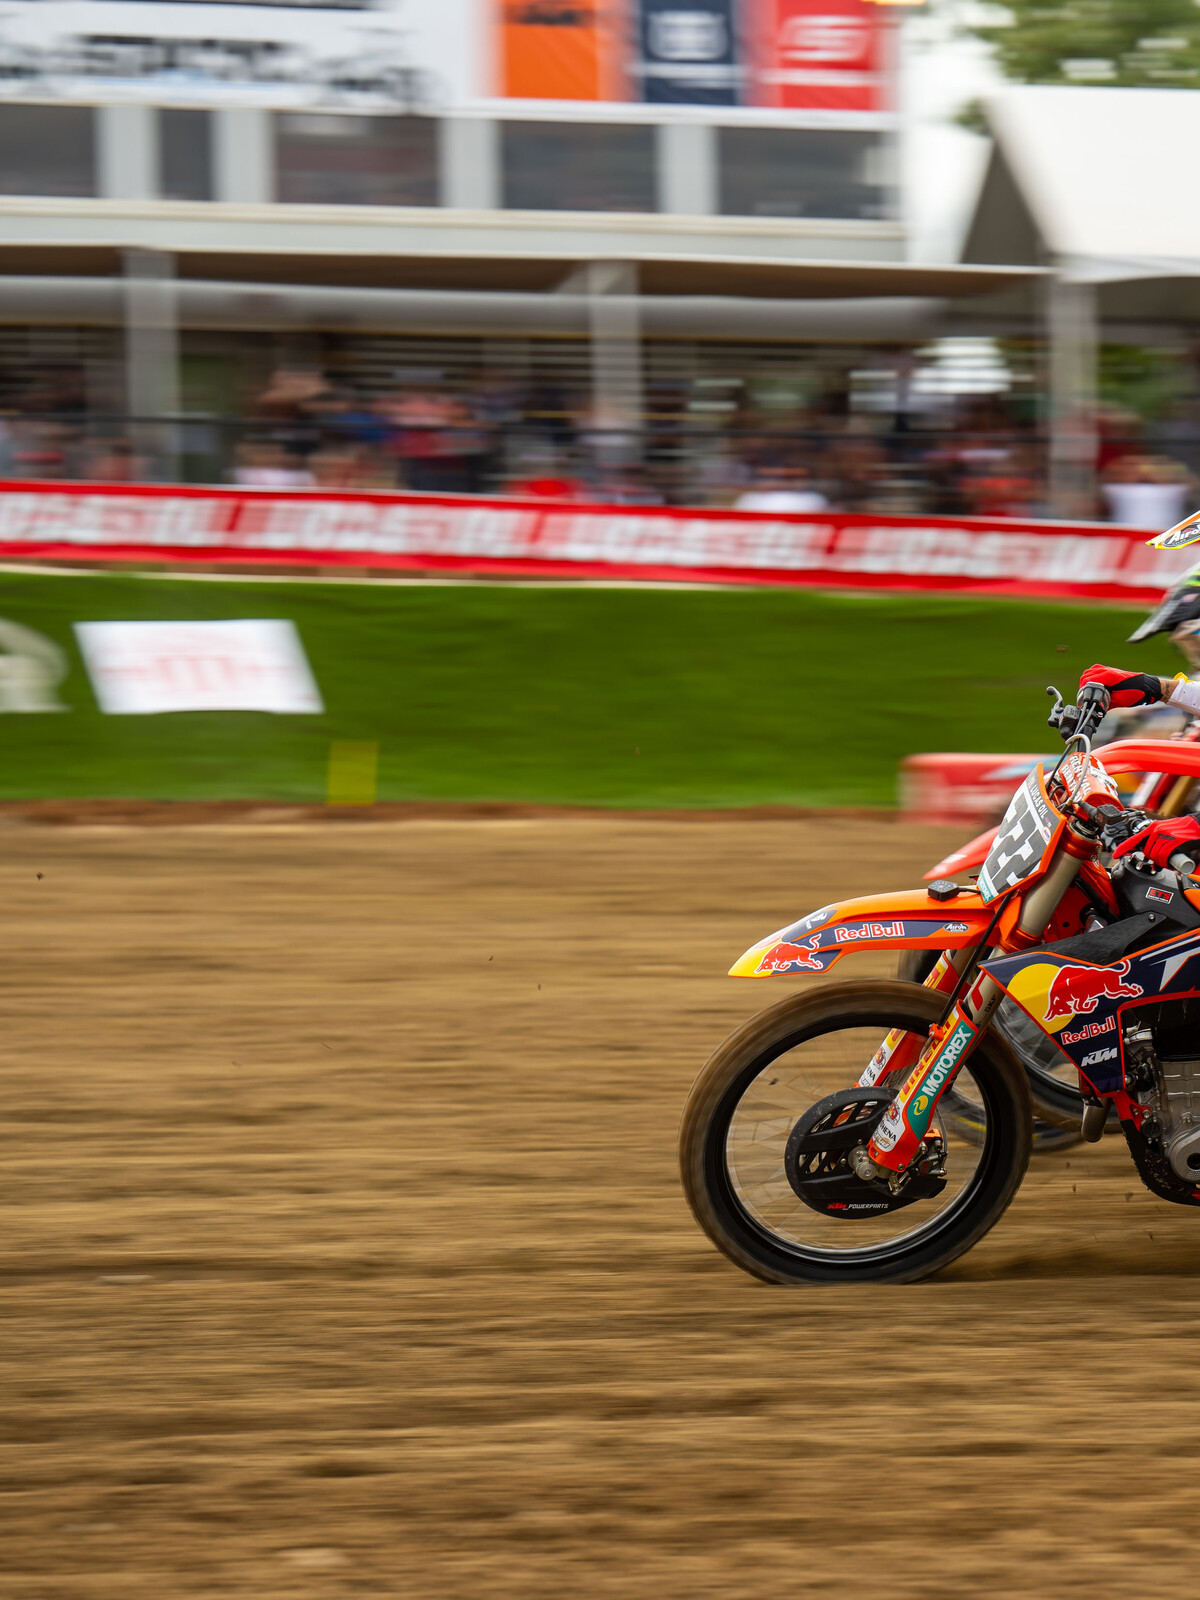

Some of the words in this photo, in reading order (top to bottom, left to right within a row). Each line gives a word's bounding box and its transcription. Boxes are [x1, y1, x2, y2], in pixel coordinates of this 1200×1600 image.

[1030, 786, 1044, 808] LUCAS
[1039, 806, 1049, 820] OIL
[835, 925, 870, 942] Red
[871, 921, 905, 937] Bull
[1061, 1026, 1090, 1046] Red
[1088, 1015, 1117, 1041] Bull
[922, 1027, 972, 1097] MOTOREX
[1081, 1047, 1118, 1068] KTM
